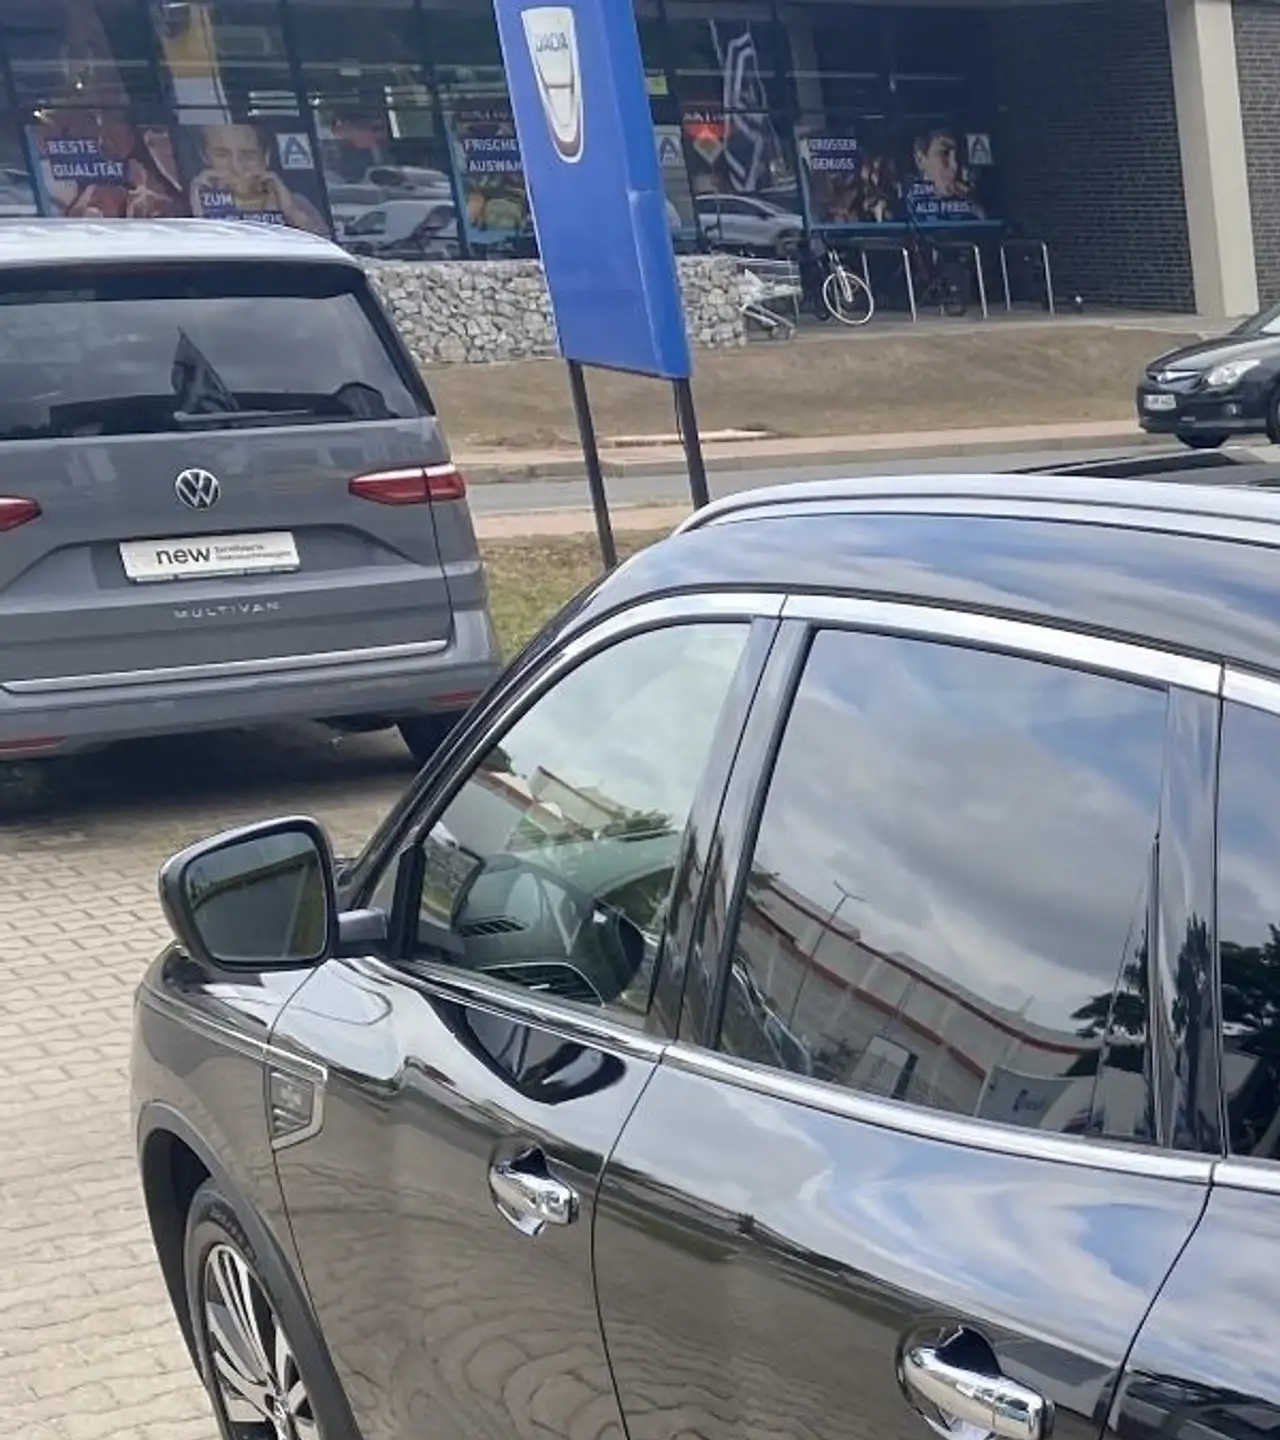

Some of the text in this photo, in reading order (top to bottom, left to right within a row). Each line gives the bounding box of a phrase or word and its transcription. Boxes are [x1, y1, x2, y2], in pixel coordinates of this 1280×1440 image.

[47, 139, 98, 154] BESTE
[464, 138, 517, 151] FRISCHE
[53, 160, 125, 178] QUALITÄT
[201, 190, 232, 206] ZUM
[155, 544, 212, 566] new
[174, 601, 281, 619] MULTIVAN
